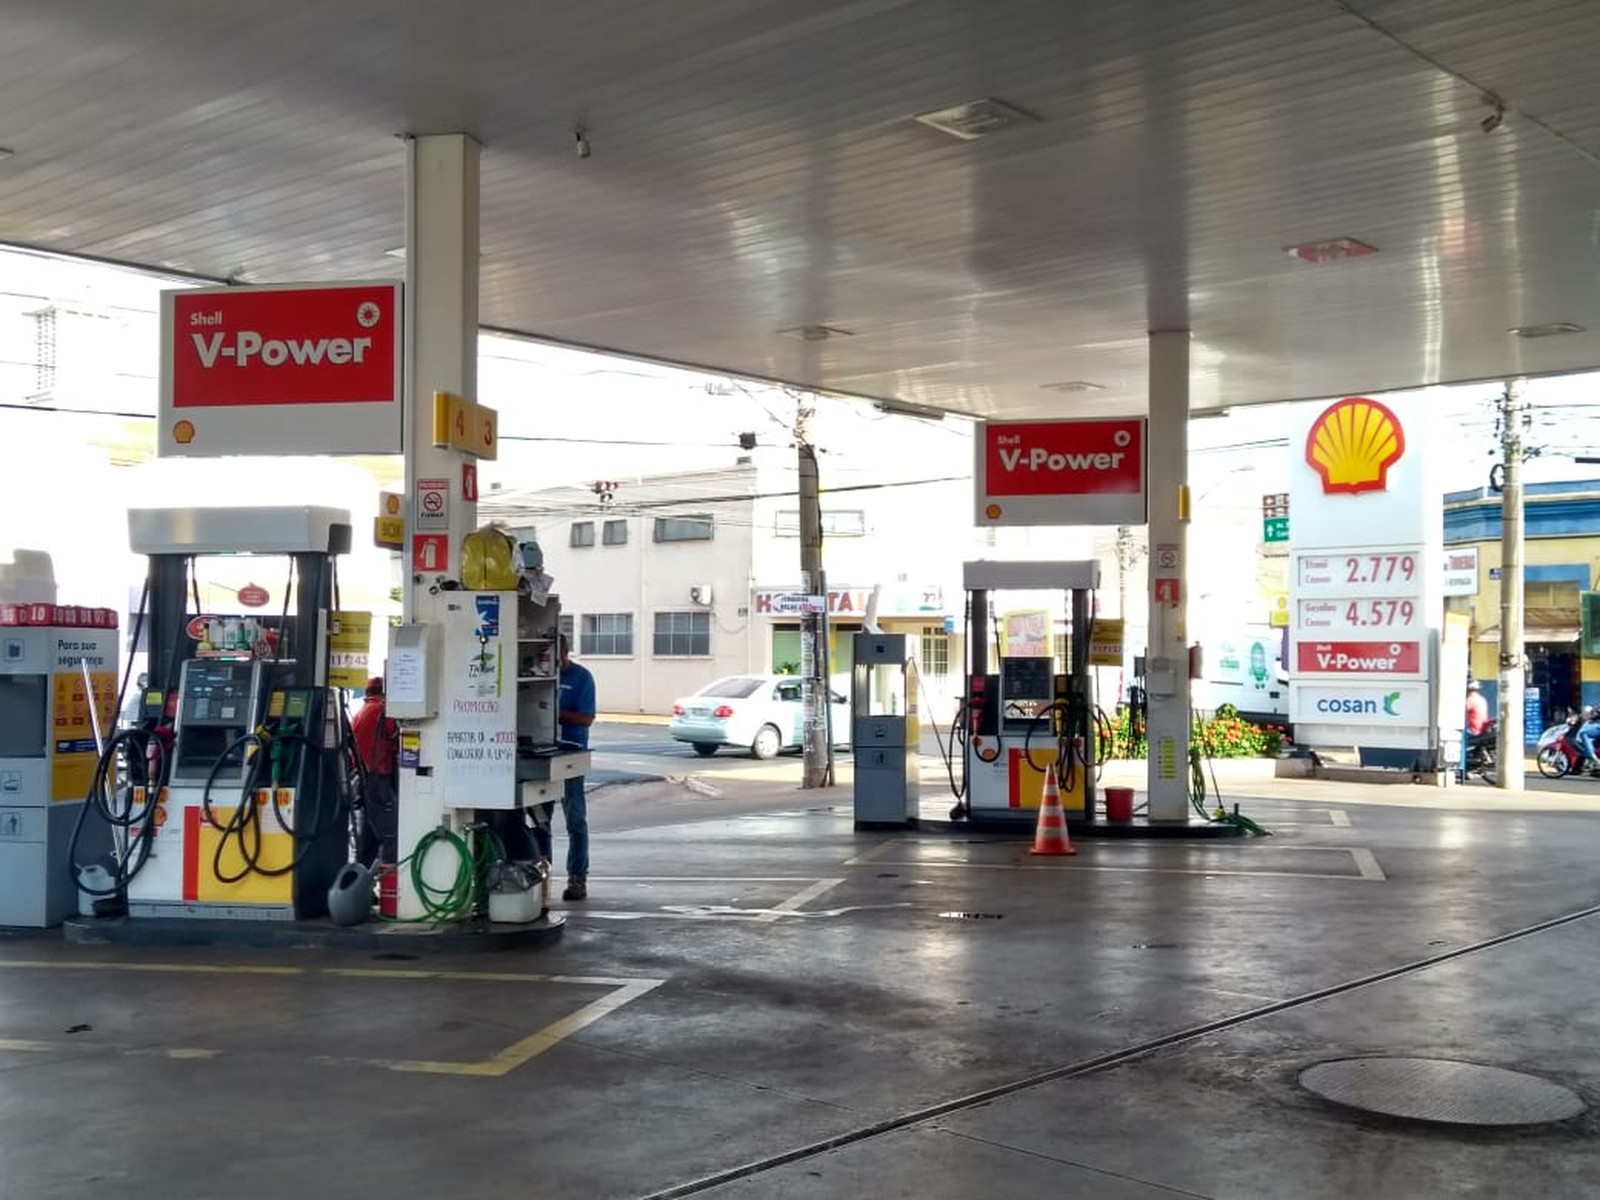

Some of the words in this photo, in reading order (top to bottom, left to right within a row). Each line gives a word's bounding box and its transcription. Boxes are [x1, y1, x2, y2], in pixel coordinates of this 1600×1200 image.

[190, 311, 222, 326] Shell
[191, 331, 372, 368] V-Power
[456, 409, 464, 436] 4
[484, 420, 492, 446] 3
[999, 448, 1125, 472] V-Power
[1346, 555, 1414, 582] 2.779
[1346, 600, 1414, 626] 4.579
[57, 639, 79, 651] Para
[81, 641, 97, 651] sua
[57, 656, 104, 668] segurnça
[1317, 653, 1397, 670] V-Power
[1317, 699, 1377, 714] cosan
